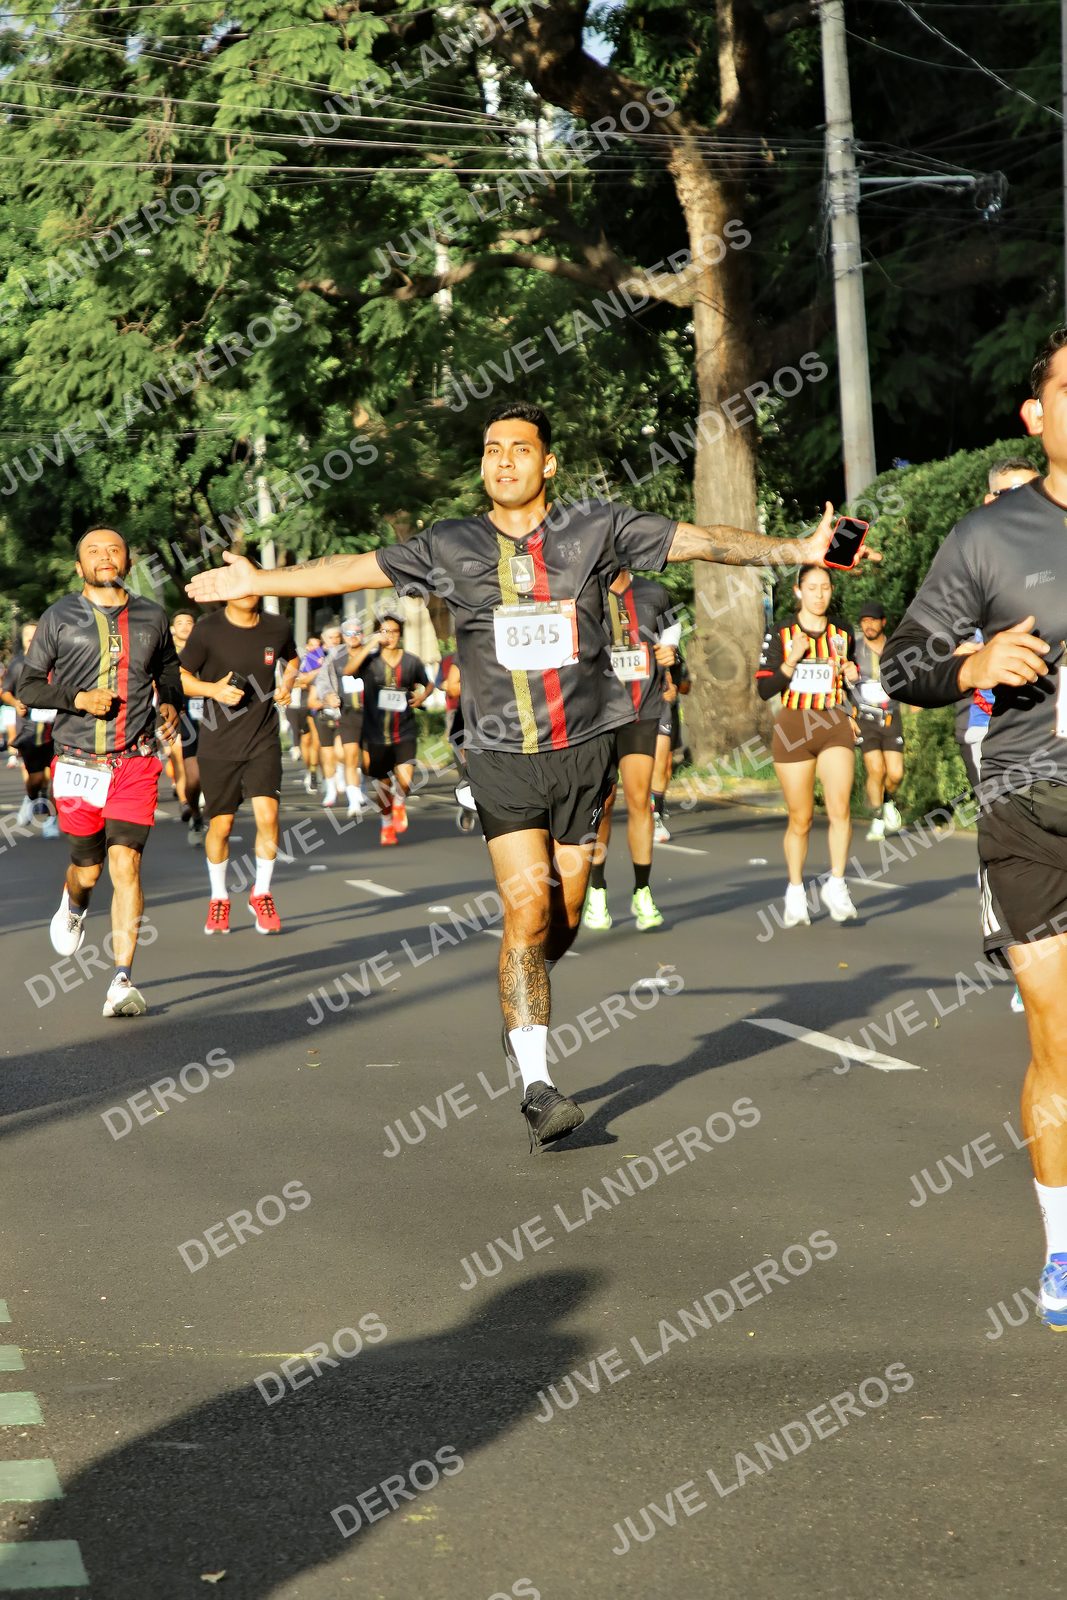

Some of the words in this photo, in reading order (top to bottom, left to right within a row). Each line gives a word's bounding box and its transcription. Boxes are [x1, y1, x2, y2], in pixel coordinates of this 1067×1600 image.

[506, 622, 560, 648] 8545
[612, 656, 641, 668] 8118
[796, 669, 830, 680] 12150
[65, 771, 99, 791] 1017
